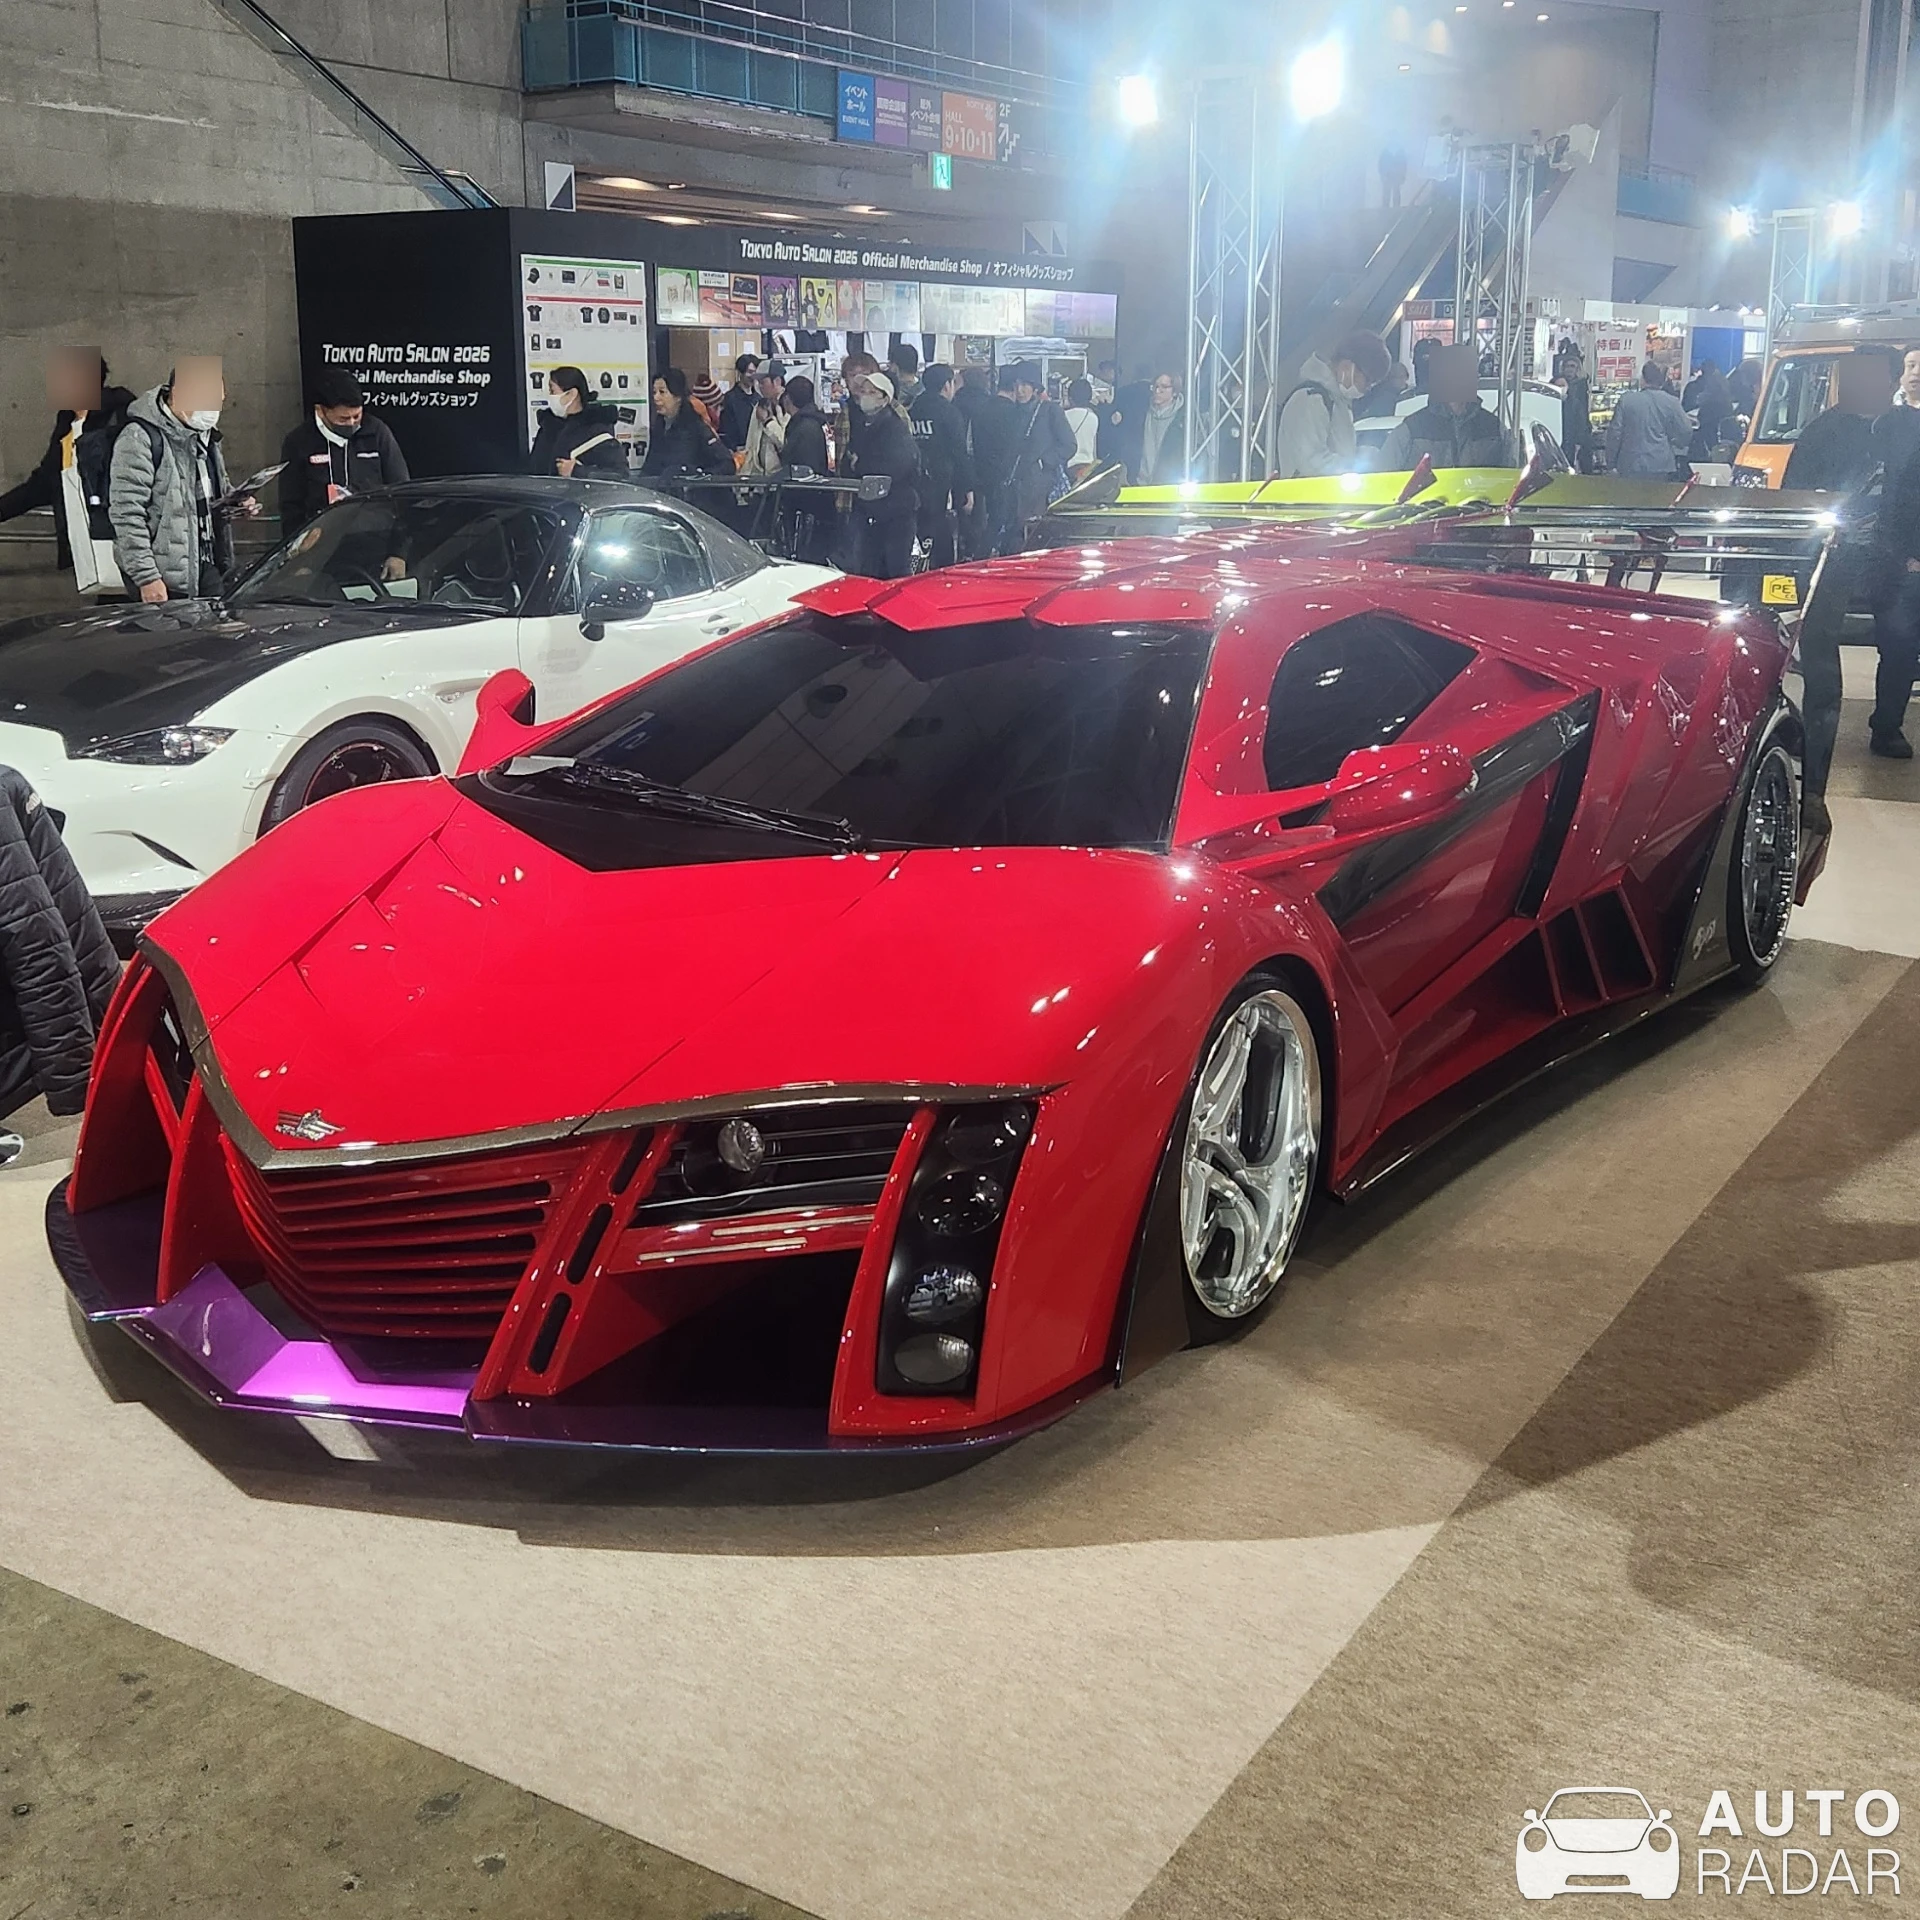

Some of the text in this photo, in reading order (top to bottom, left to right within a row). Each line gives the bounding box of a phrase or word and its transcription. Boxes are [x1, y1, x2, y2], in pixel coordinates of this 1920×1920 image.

[845, 85, 868, 99] イベント
[846, 98, 866, 113] ホール
[999, 103, 1011, 117] 2F
[945, 110, 964, 124] HALL
[740, 238, 772, 259] TOKYO
[774, 241, 800, 261] AUTO
[802, 243, 832, 264] SALON
[833, 249, 858, 265] 2026
[862, 252, 898, 269] Official
[900, 254, 958, 273] Merchandise
[960, 259, 982, 277] Shop
[993, 261, 1074, 281] オフィシャルグッズショップ
[322, 343, 491, 363] TOKYO AUTO SALON 2026
[373, 369, 454, 384] Merchandise
[457, 369, 491, 387] Shop
[362, 391, 478, 407] フィシャルグッズショップ
